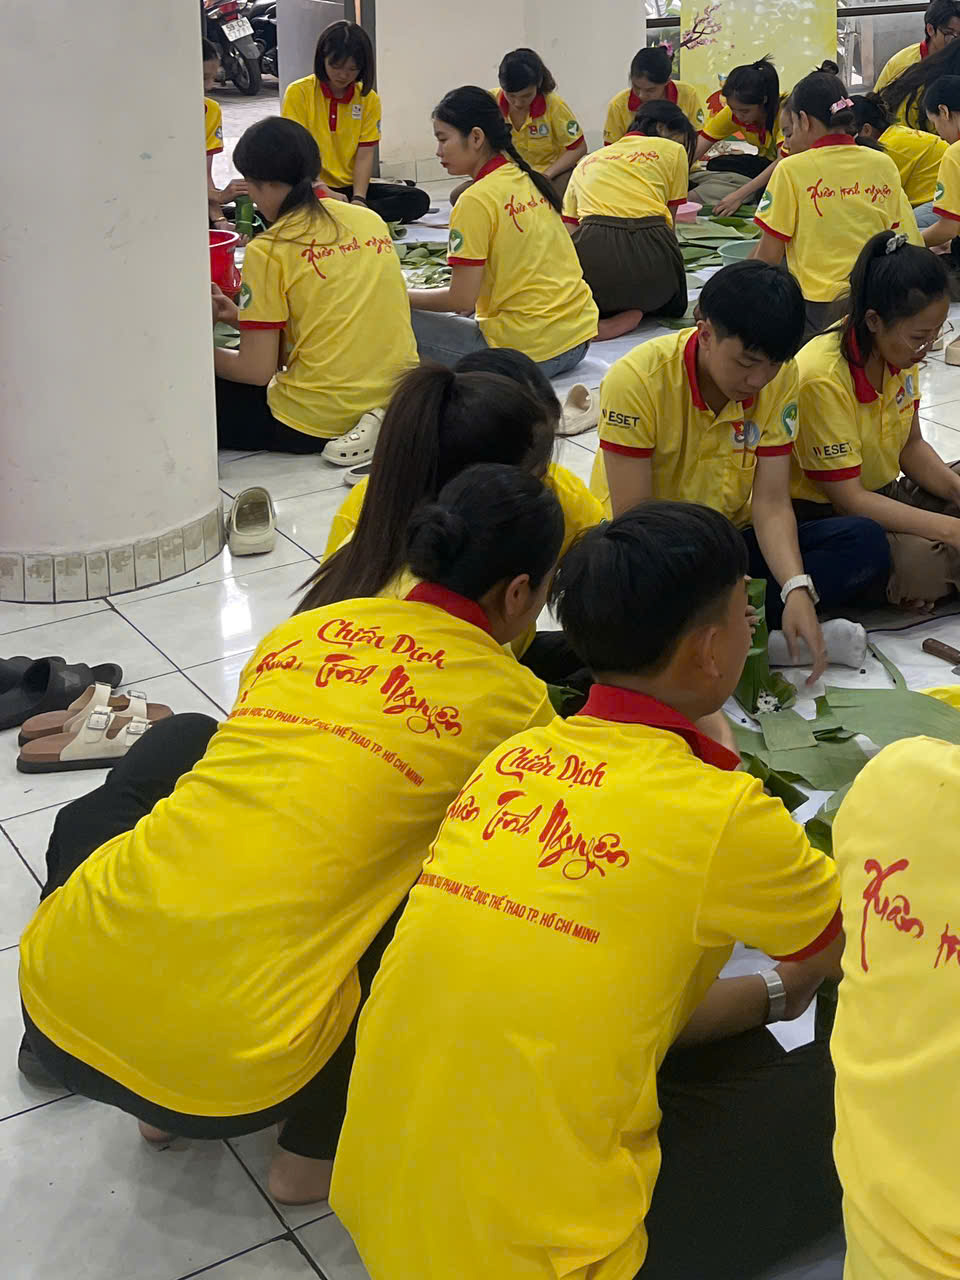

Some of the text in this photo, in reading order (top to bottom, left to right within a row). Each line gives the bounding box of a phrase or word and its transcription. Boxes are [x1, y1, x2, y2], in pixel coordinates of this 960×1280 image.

[608, 411, 640, 427] ESET
[391, 634, 445, 669] Dịch
[557, 754, 607, 788] Dịch
[503, 899, 526, 918] THAO
[554, 917, 574, 935] CHÍ
[572, 923, 600, 944] MINH
